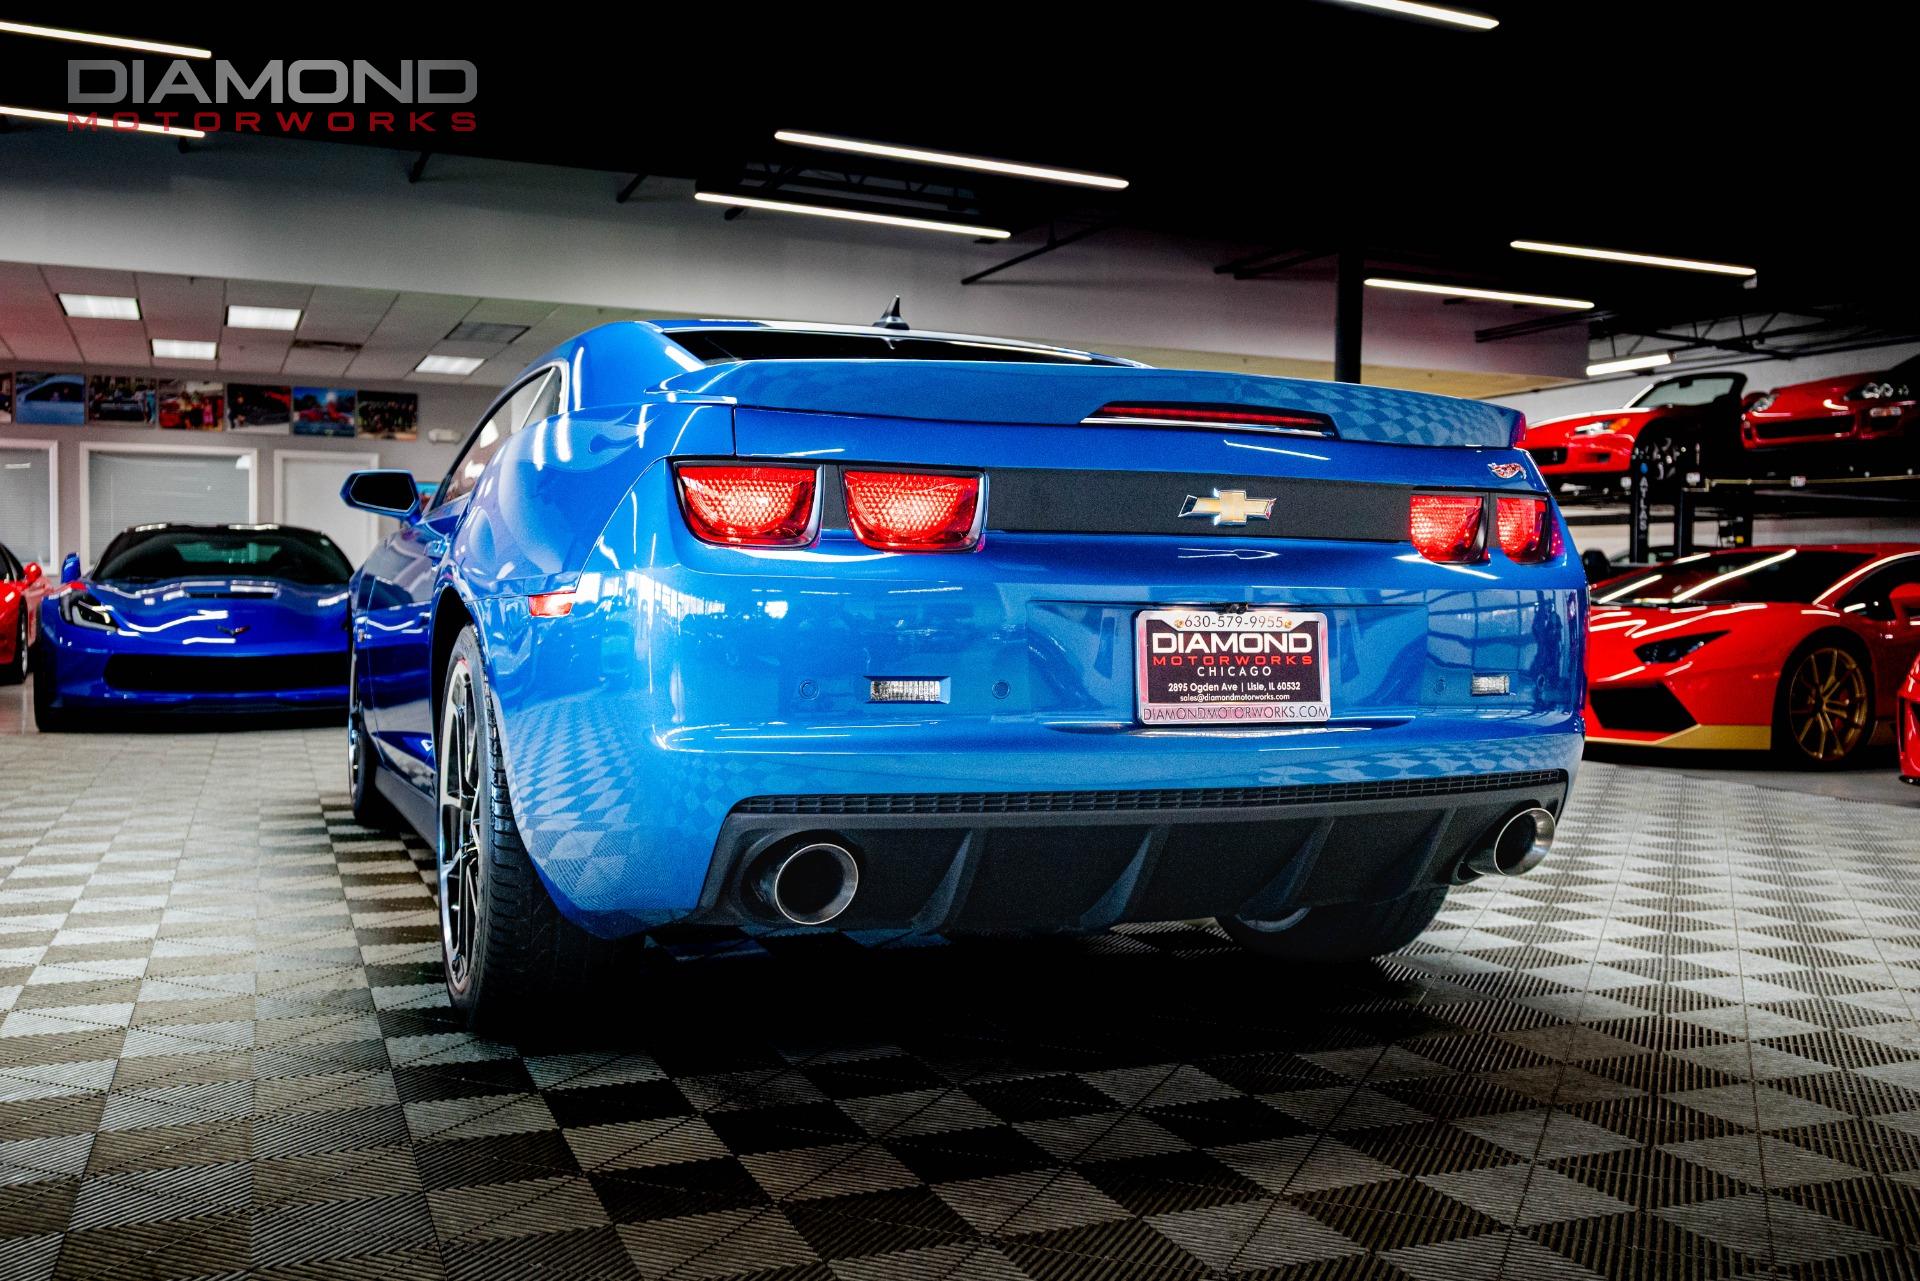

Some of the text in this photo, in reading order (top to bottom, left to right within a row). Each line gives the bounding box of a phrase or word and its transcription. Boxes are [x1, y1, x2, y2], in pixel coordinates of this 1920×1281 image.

[1639, 476, 1649, 531] ATLAS
[1185, 615, 1283, 628] 630-579-9955
[1152, 633, 1312, 653] DIAMOND
[1153, 655, 1313, 666] MOTORWORKS
[1197, 666, 1272, 677] CHICAGO
[1168, 683, 1188, 692] 2895
[1190, 683, 1219, 693] Ogden
[1222, 683, 1238, 691] Ave
[1247, 682, 1266, 692] Lisle,
[1269, 682, 1275, 690] IL
[1277, 682, 1300, 690] 60532
[1180, 694, 1290, 702] sales@diamondmotorworks.com
[1144, 706, 1329, 720] DIAMONDMOTORWORKS.COM
